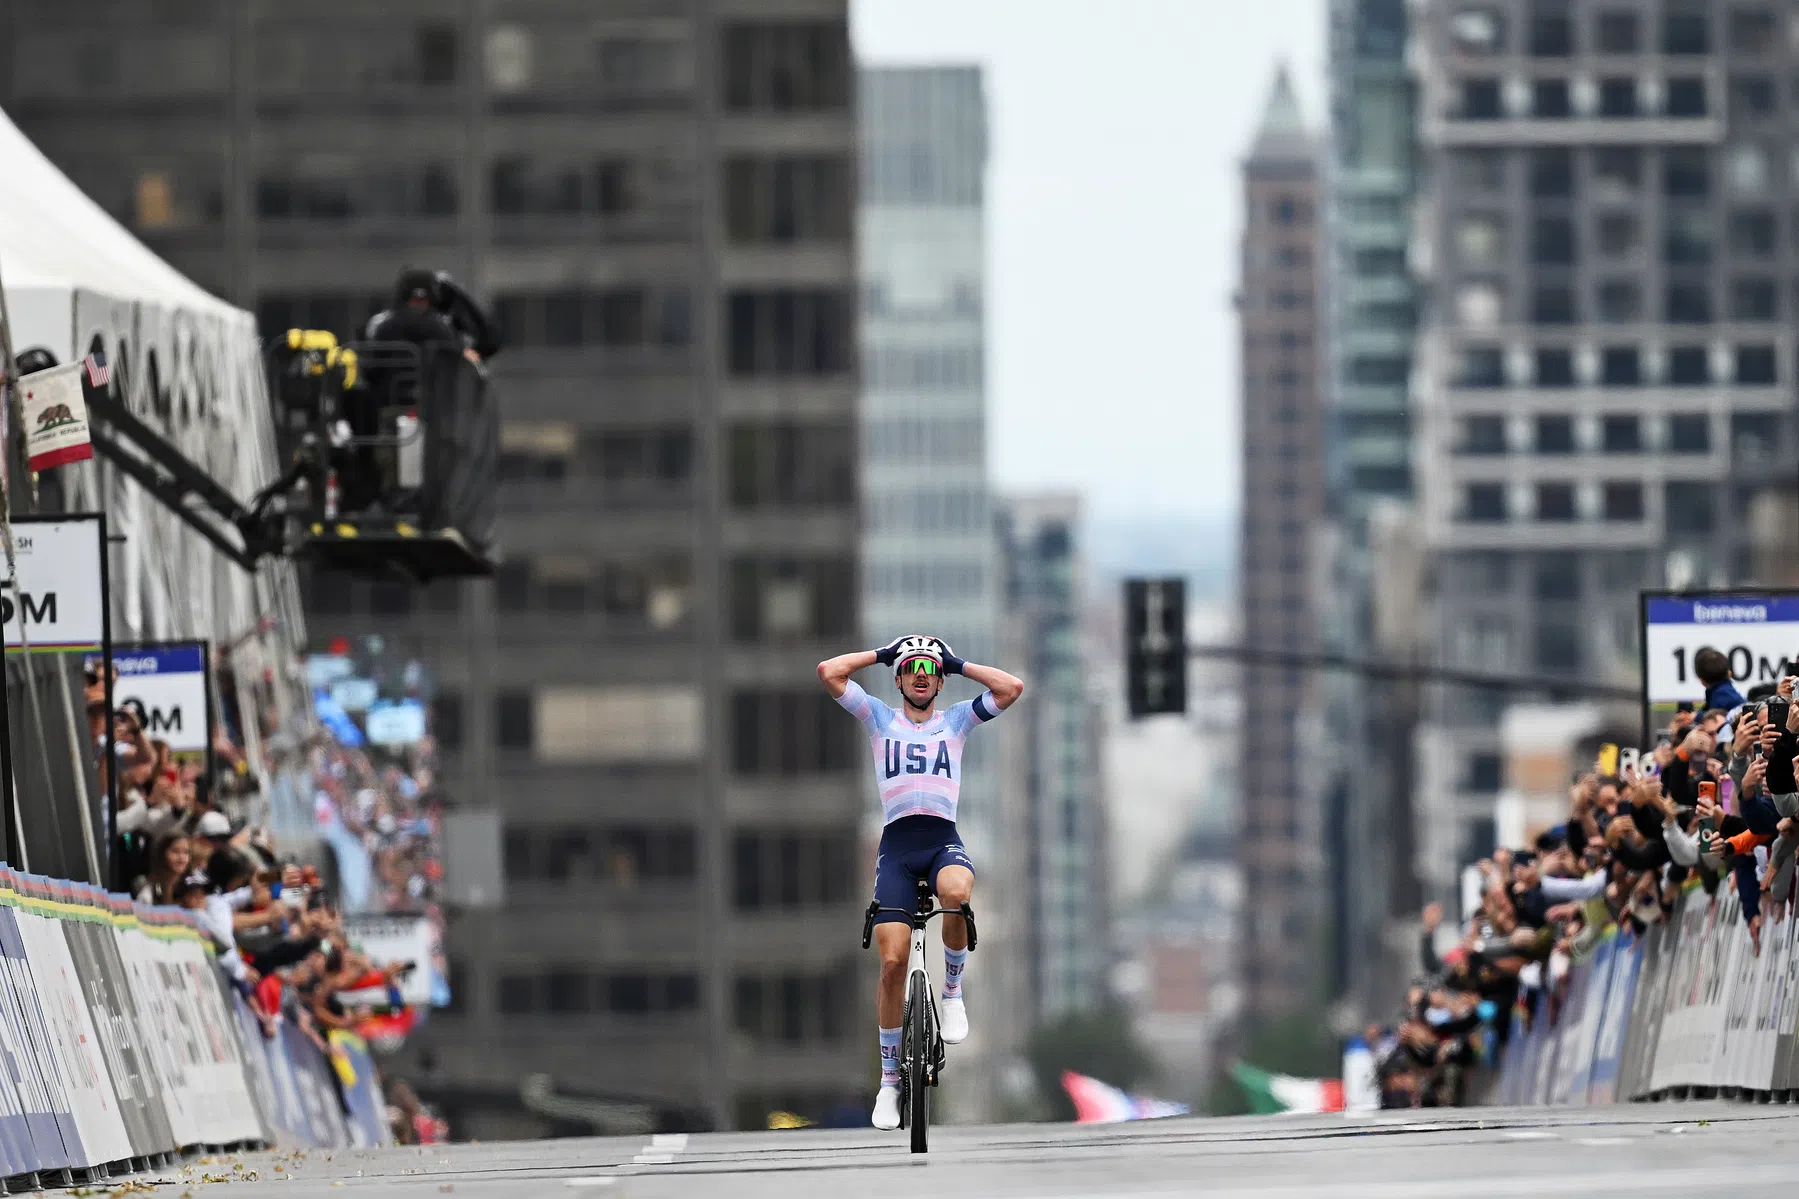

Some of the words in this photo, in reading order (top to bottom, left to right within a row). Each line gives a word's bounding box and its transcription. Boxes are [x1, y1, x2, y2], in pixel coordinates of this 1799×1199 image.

[1693, 600, 1767, 623] beneva
[1672, 645, 1789, 683] 10M
[885, 738, 952, 780] USA
